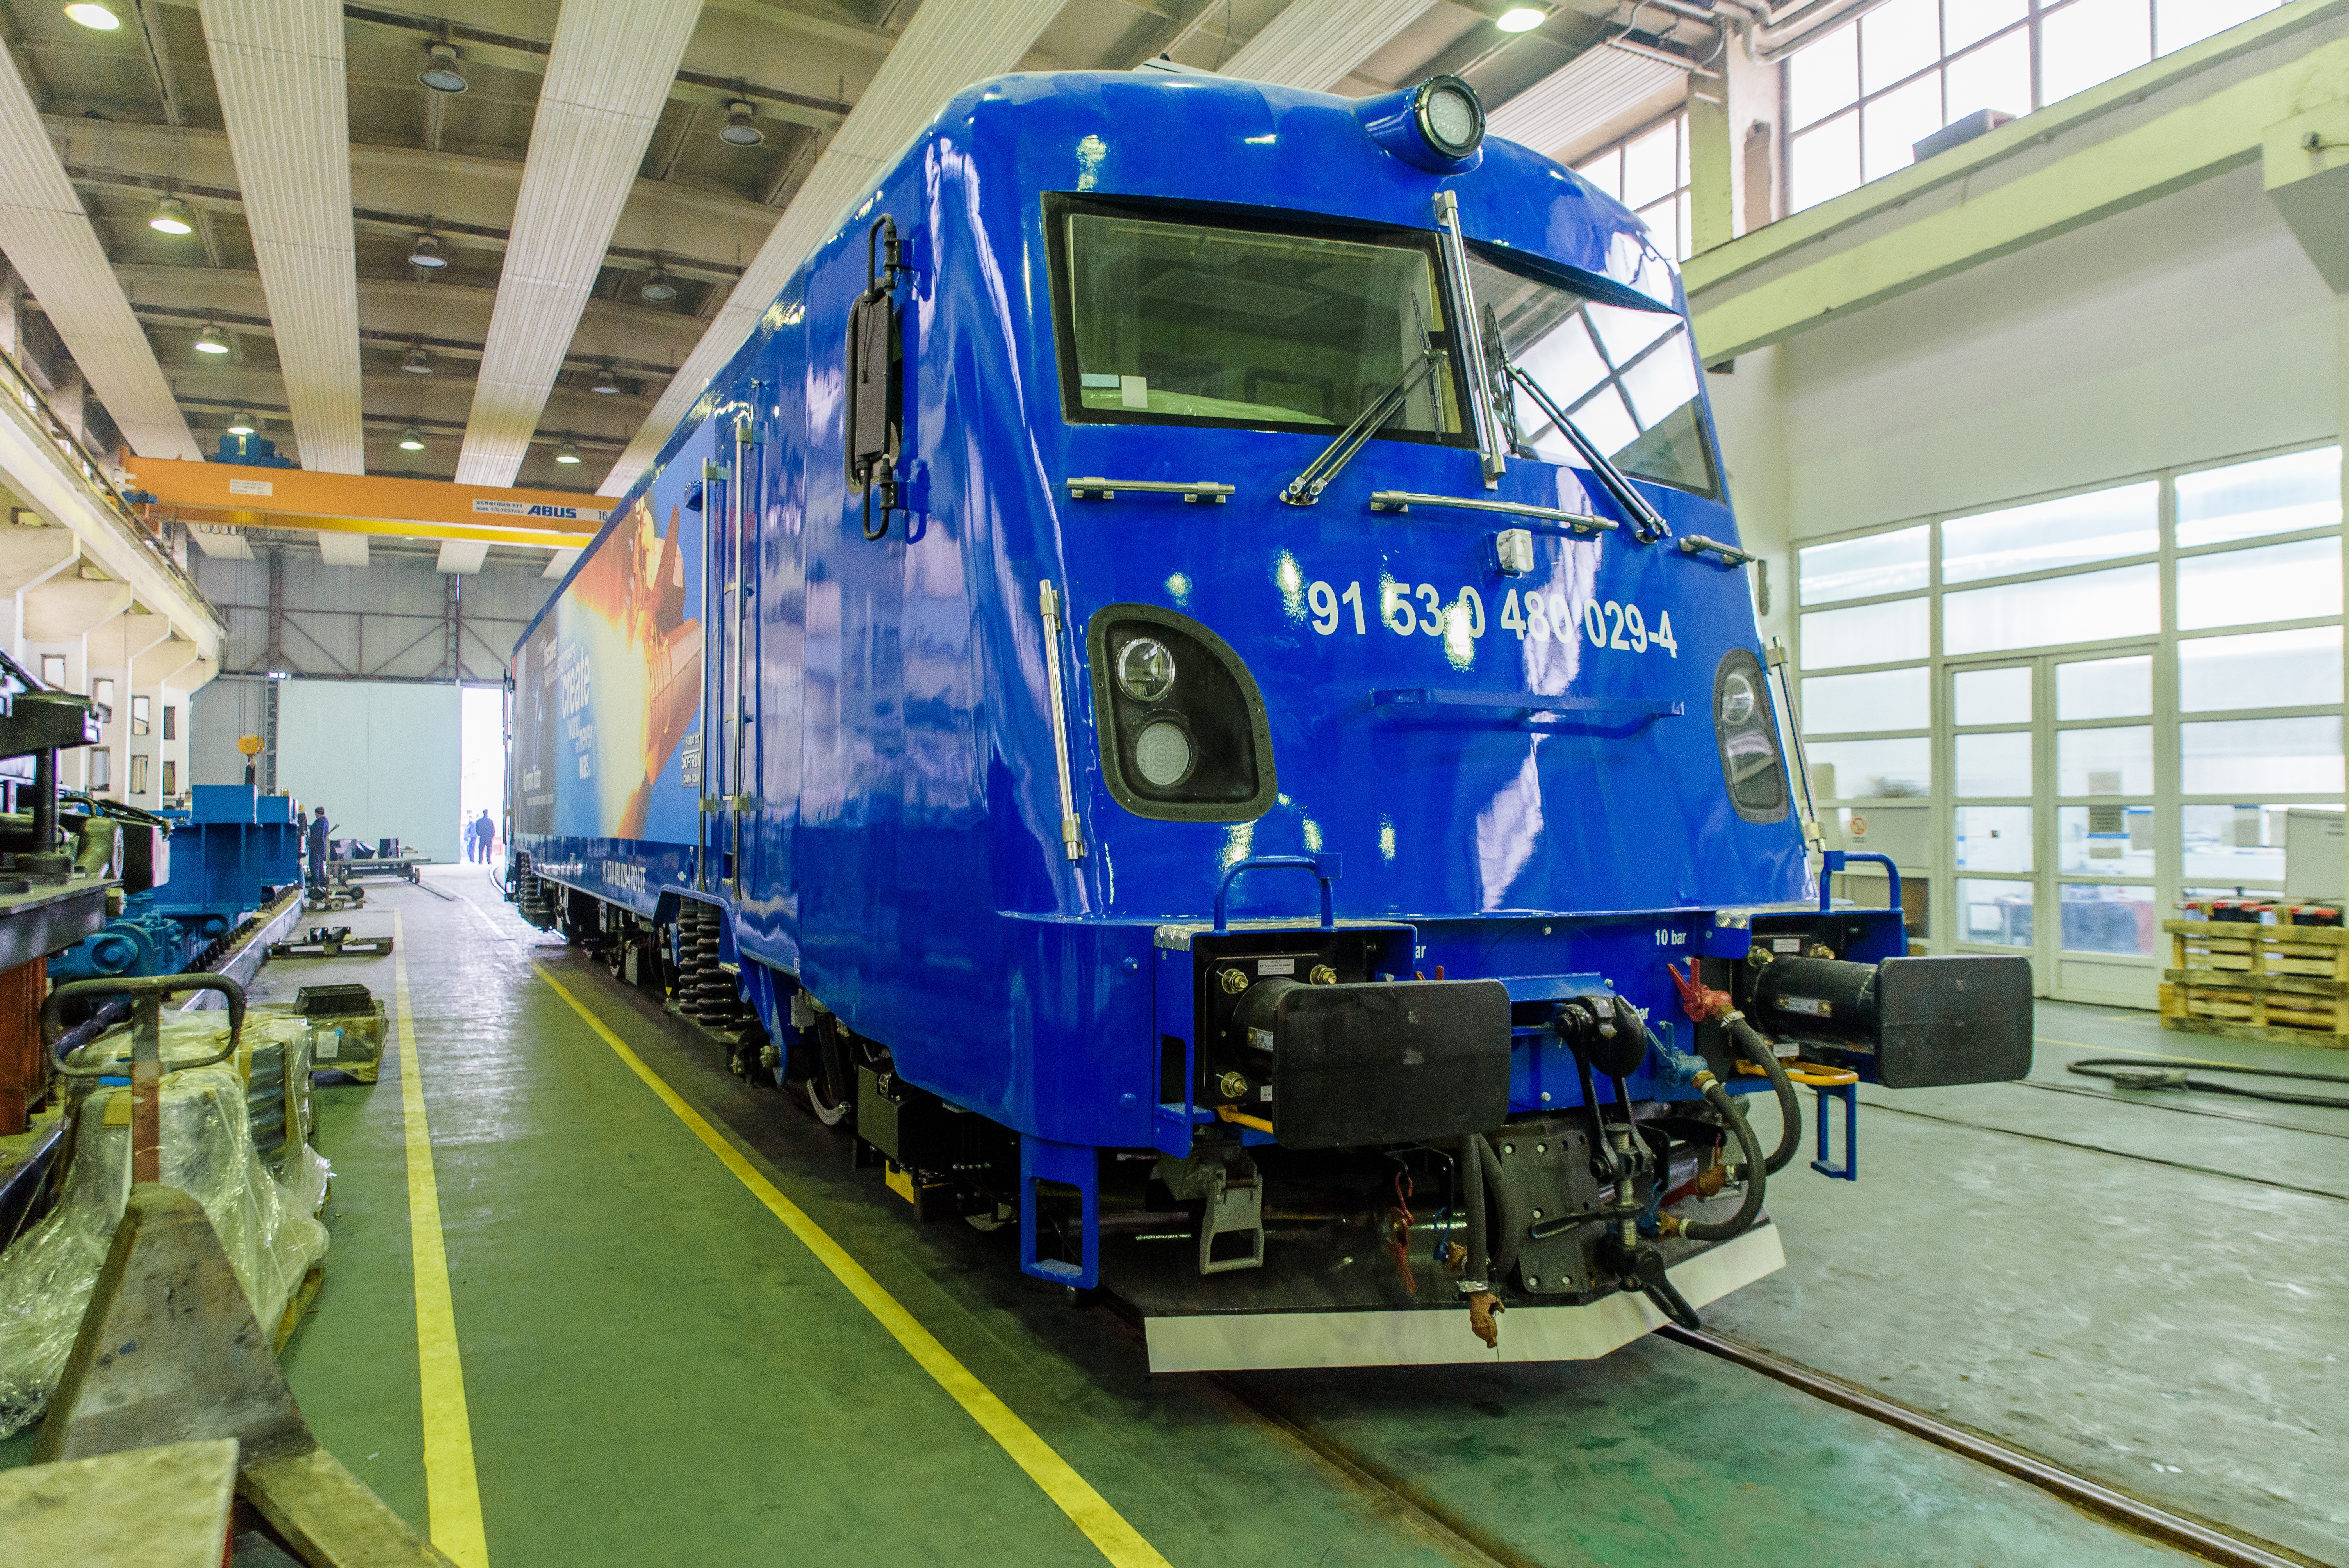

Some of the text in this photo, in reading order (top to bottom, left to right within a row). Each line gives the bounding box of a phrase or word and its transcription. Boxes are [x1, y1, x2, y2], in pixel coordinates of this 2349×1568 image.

[527, 505, 577, 519] ABUS
[1308, 581, 1678, 658] 91 53 0 480 029-4
[562, 646, 590, 719] create
[682, 751, 700, 769] SOFTRON
[638, 867, 646, 894] LTE
[1655, 929, 1687, 945] 10 bar
[1415, 945, 1426, 959] ar
